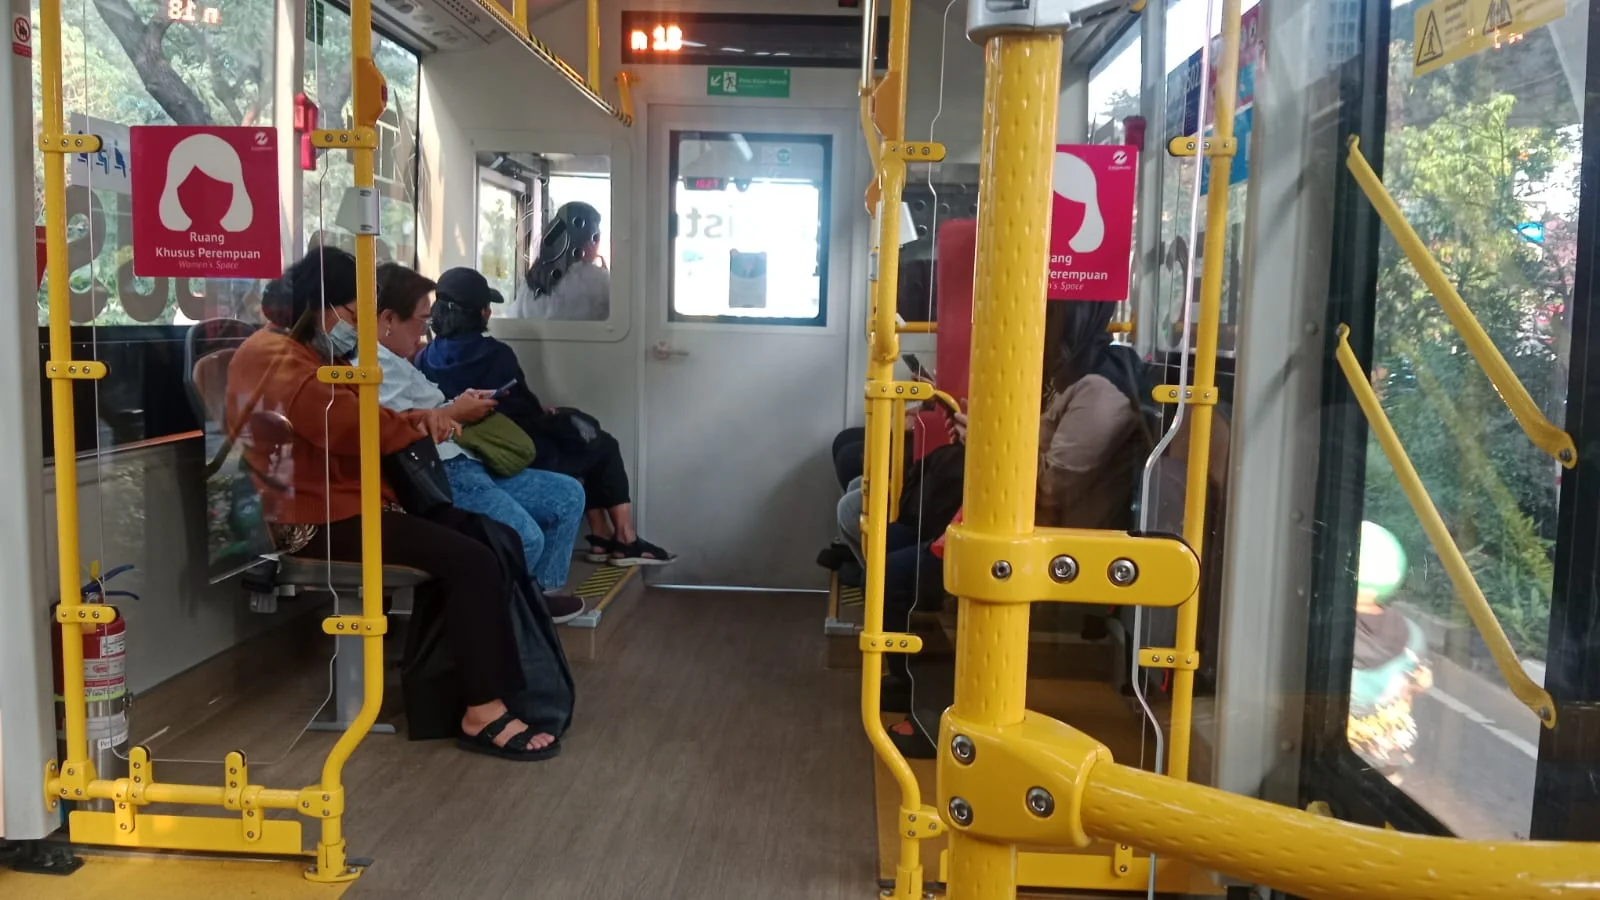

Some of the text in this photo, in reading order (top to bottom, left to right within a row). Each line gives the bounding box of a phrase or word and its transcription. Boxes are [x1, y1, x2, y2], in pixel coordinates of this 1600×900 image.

[190, 231, 225, 245] Ruang
[155, 247, 261, 260] Khusus Perempuan
[178, 260, 239, 270] Women's Space
[1048, 254, 1072, 266] ang
[1059, 281, 1084, 291] Space
